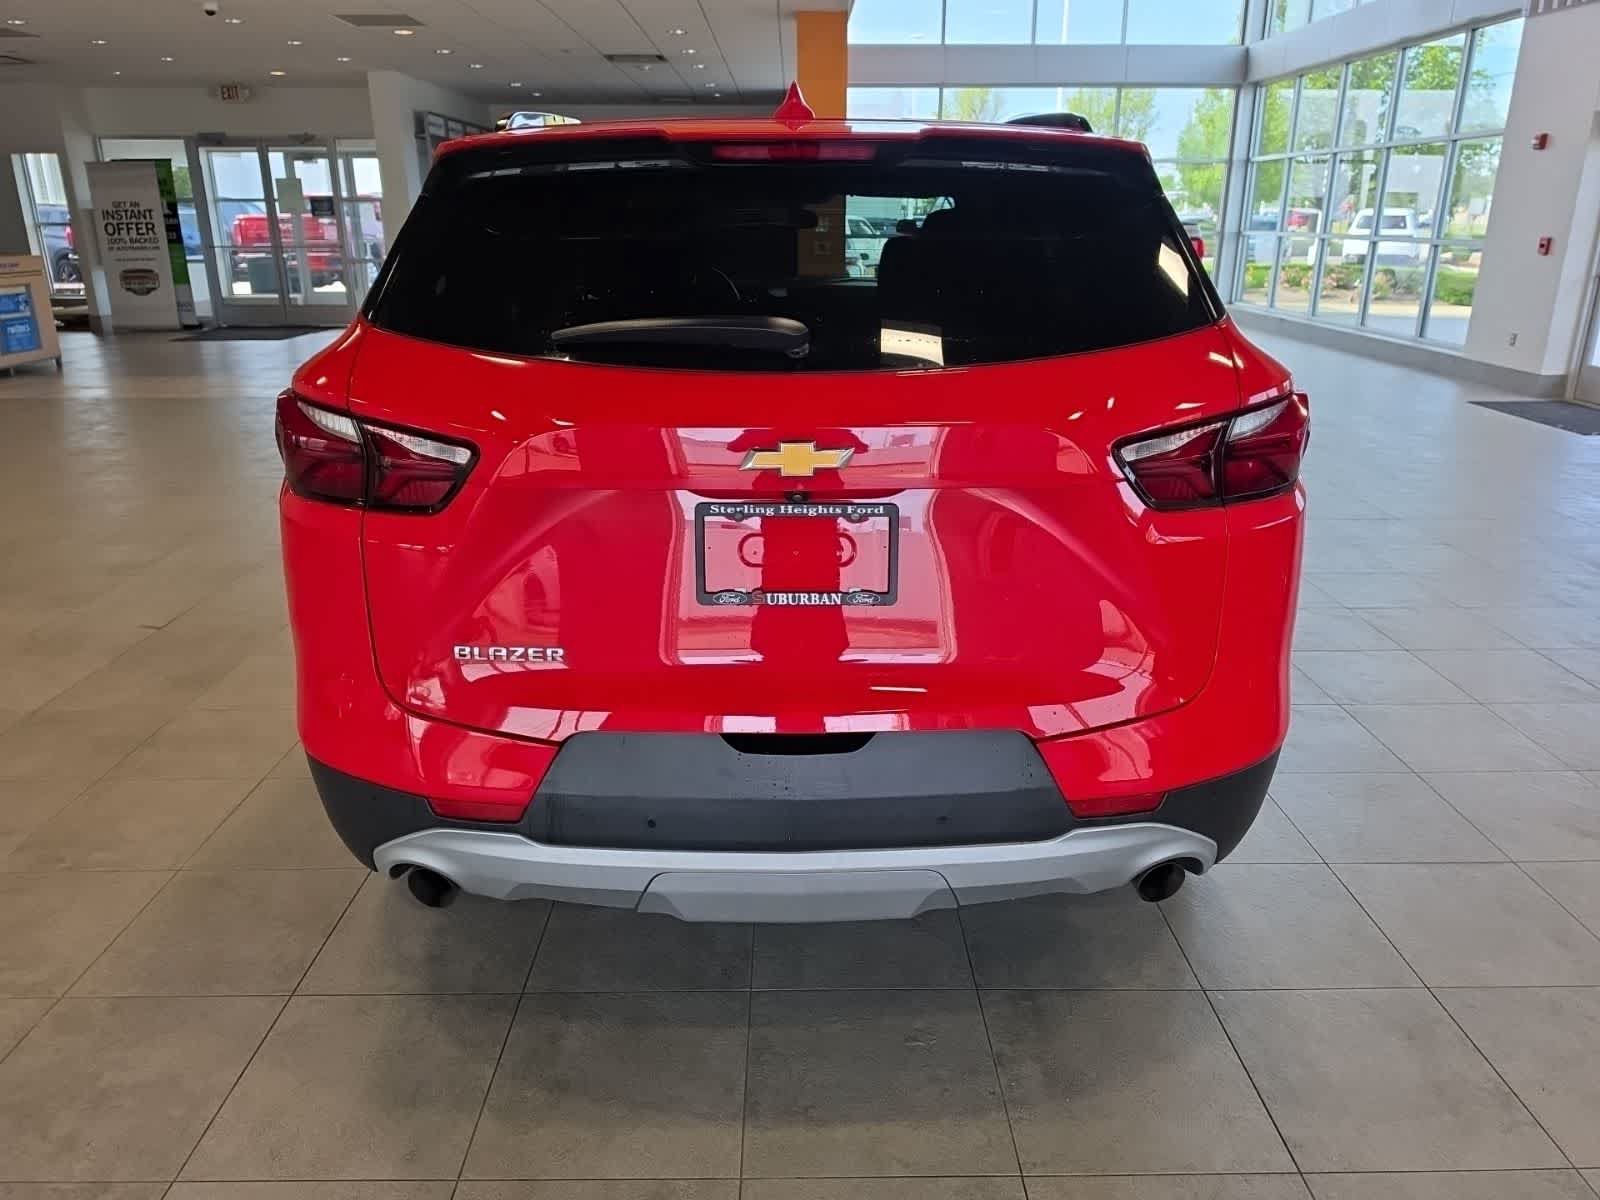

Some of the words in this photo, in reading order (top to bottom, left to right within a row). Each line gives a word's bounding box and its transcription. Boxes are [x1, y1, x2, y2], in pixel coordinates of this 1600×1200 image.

[221, 86, 240, 100] EXIT
[102, 209, 154, 220] INSTANT
[104, 222, 157, 236] OFFER
[709, 504, 774, 516] Sterling
[779, 504, 842, 516] Heights
[847, 504, 884, 515] Ford
[453, 645, 565, 662] BLAZER
